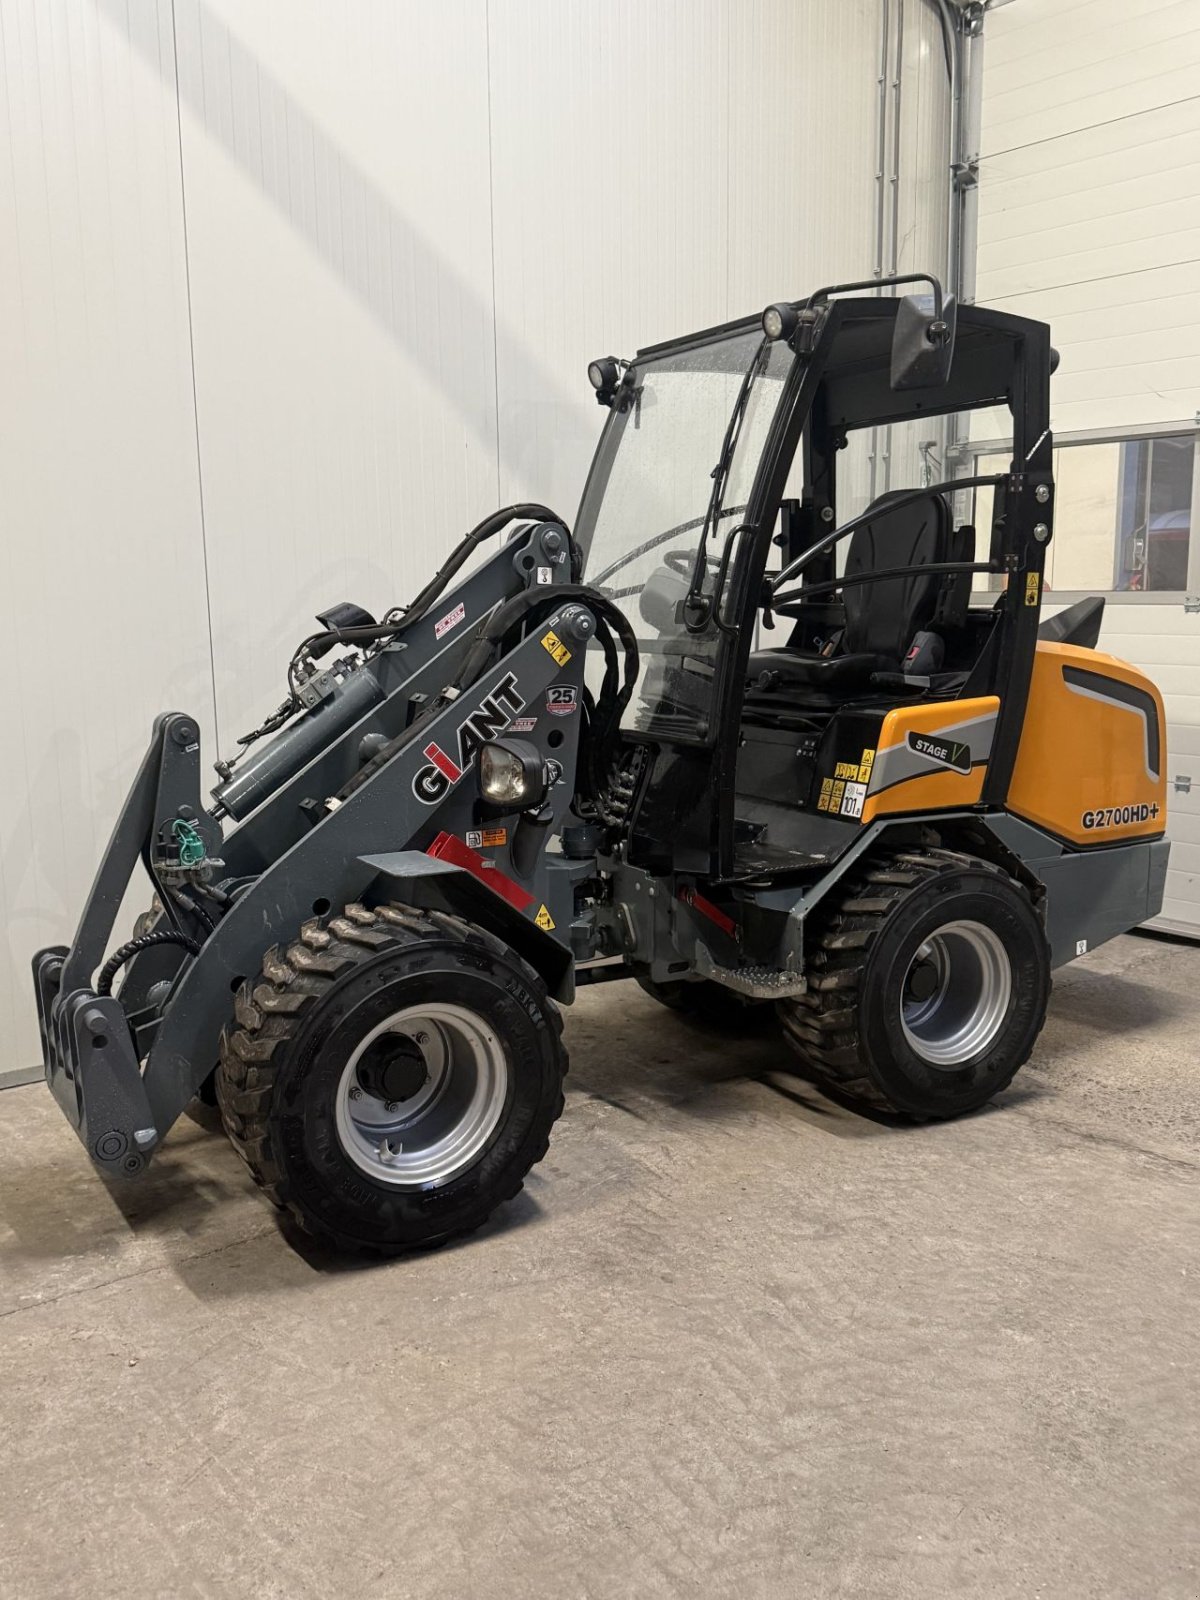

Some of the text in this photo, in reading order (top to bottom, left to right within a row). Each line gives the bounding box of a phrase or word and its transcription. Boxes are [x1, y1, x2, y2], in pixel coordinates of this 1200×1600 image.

[551, 689, 573, 704] 25
[412, 672, 525, 804] GIANT
[915, 740, 968, 763] STAGE V
[844, 796, 857, 815] 101
[1082, 803, 1159, 829] G2700HD+
